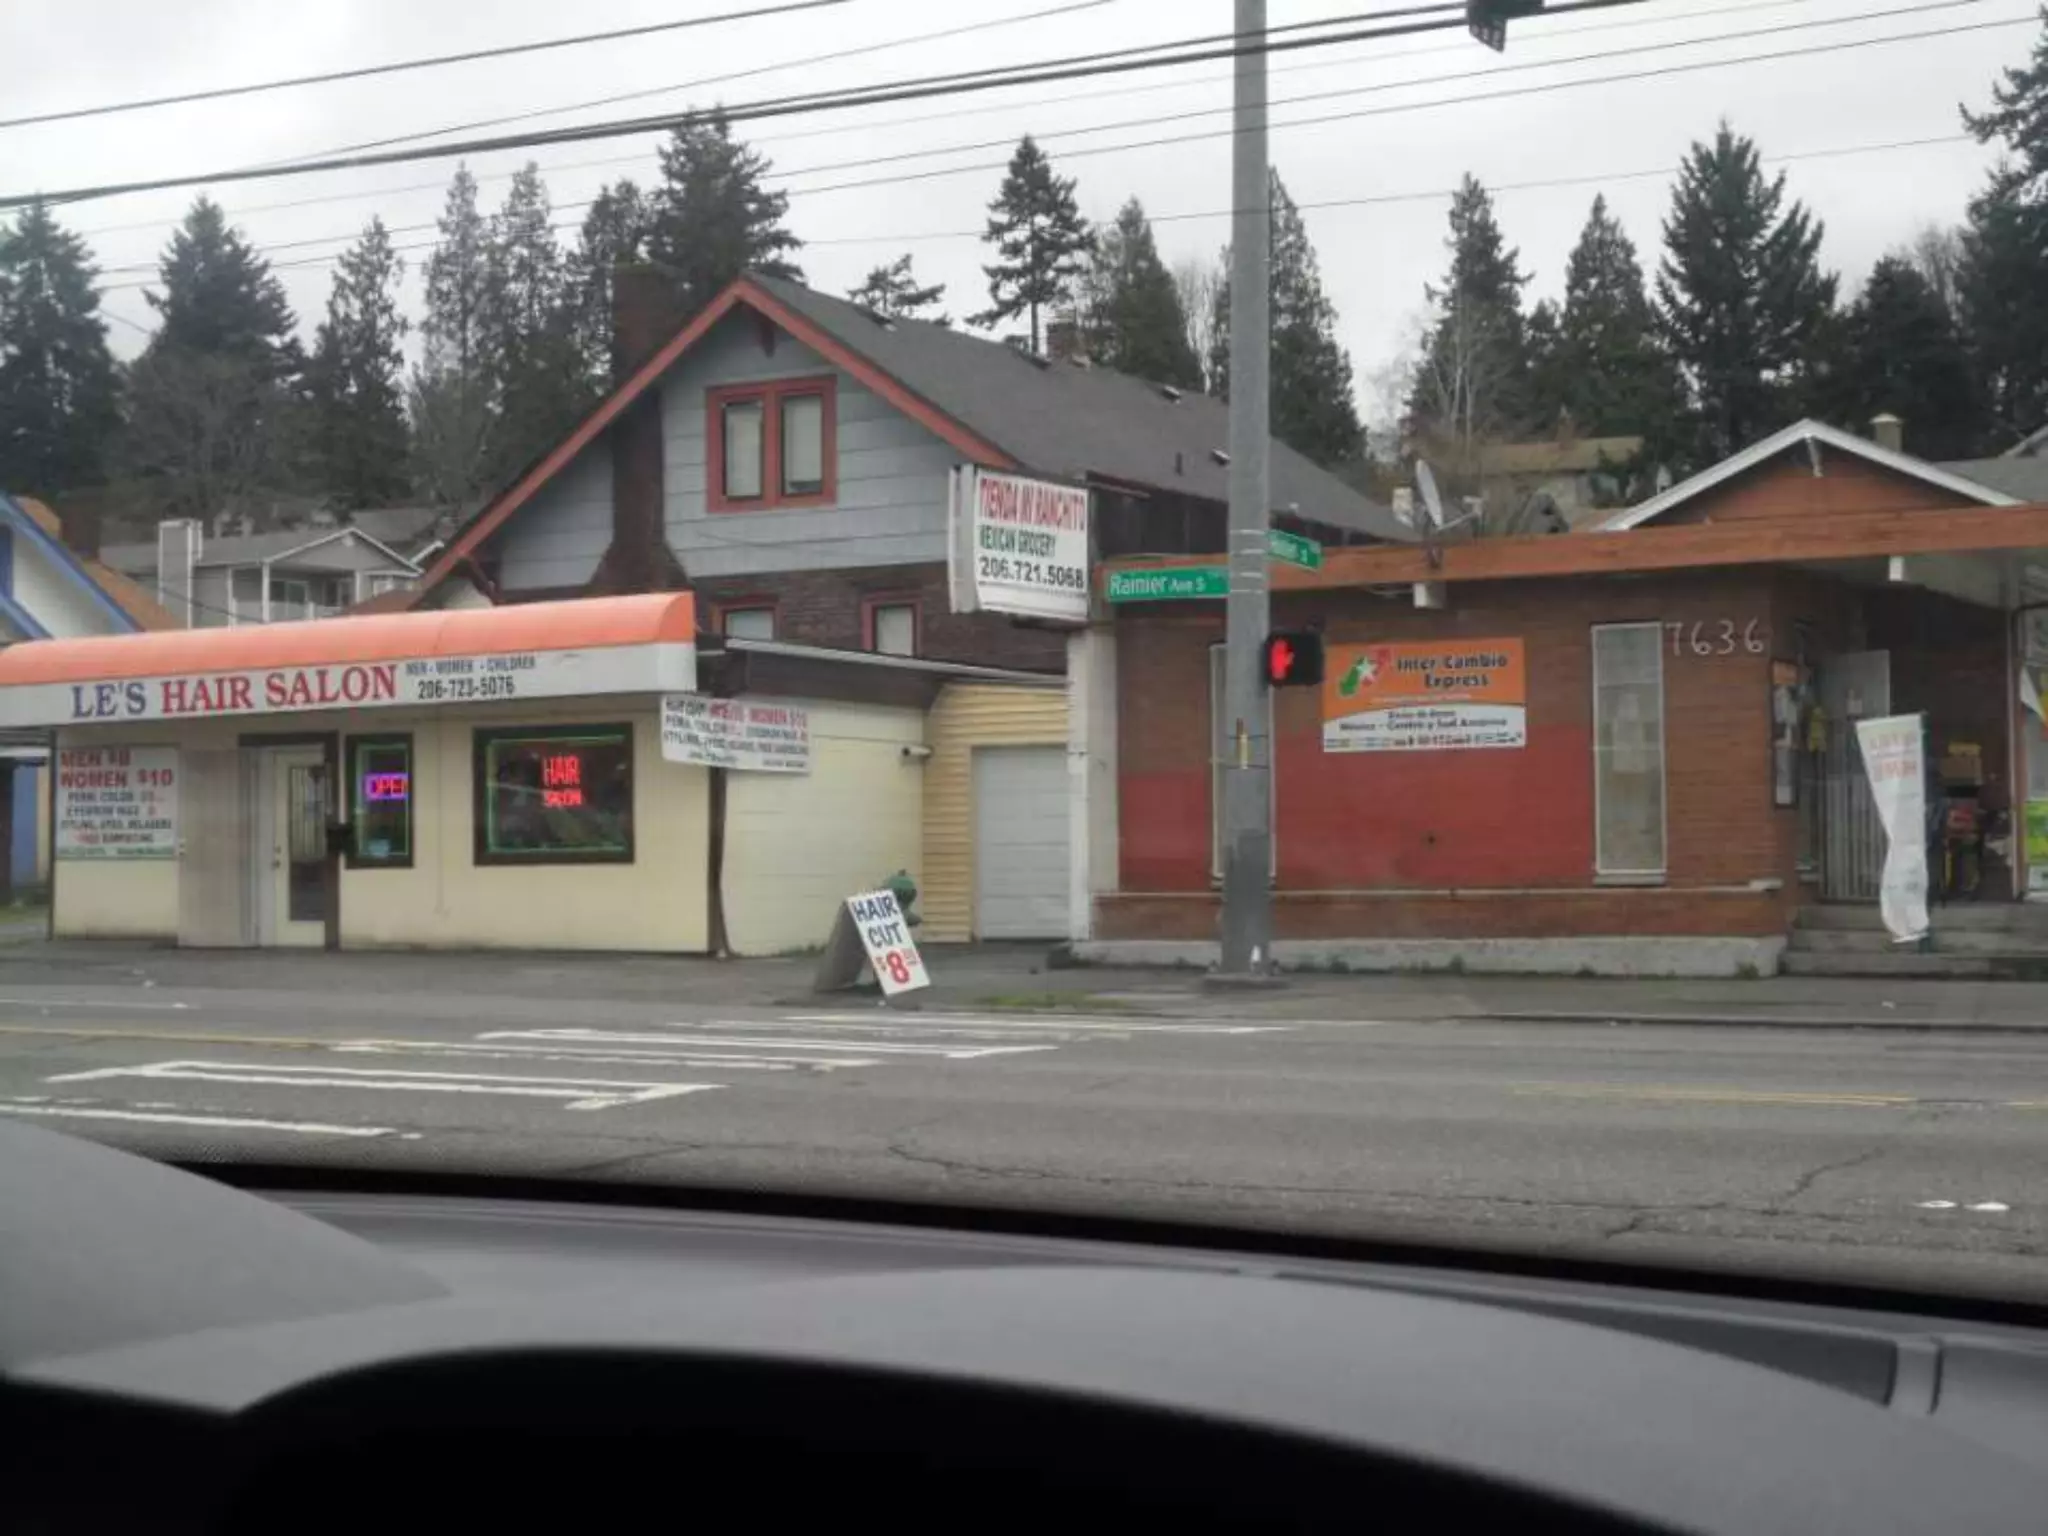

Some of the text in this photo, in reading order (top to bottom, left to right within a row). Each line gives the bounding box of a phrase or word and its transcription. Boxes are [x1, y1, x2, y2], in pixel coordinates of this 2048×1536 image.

[980, 524, 1016, 554] MEXICAN
[979, 557, 1085, 589] 206.721.5068
[1109, 573, 1168, 597] Rainier
[1196, 576, 1207, 592] S
[1665, 618, 1765, 656] 7636
[72, 665, 397, 719] LE'S HAIR SALON
[418, 675, 514, 699] 206-723-5076
[61, 751, 103, 768] MEN
[543, 755, 581, 787] HAIR
[61, 768, 173, 788] WOMEN $10
[853, 895, 898, 922] HAIR
[868, 923, 903, 948] CUT
